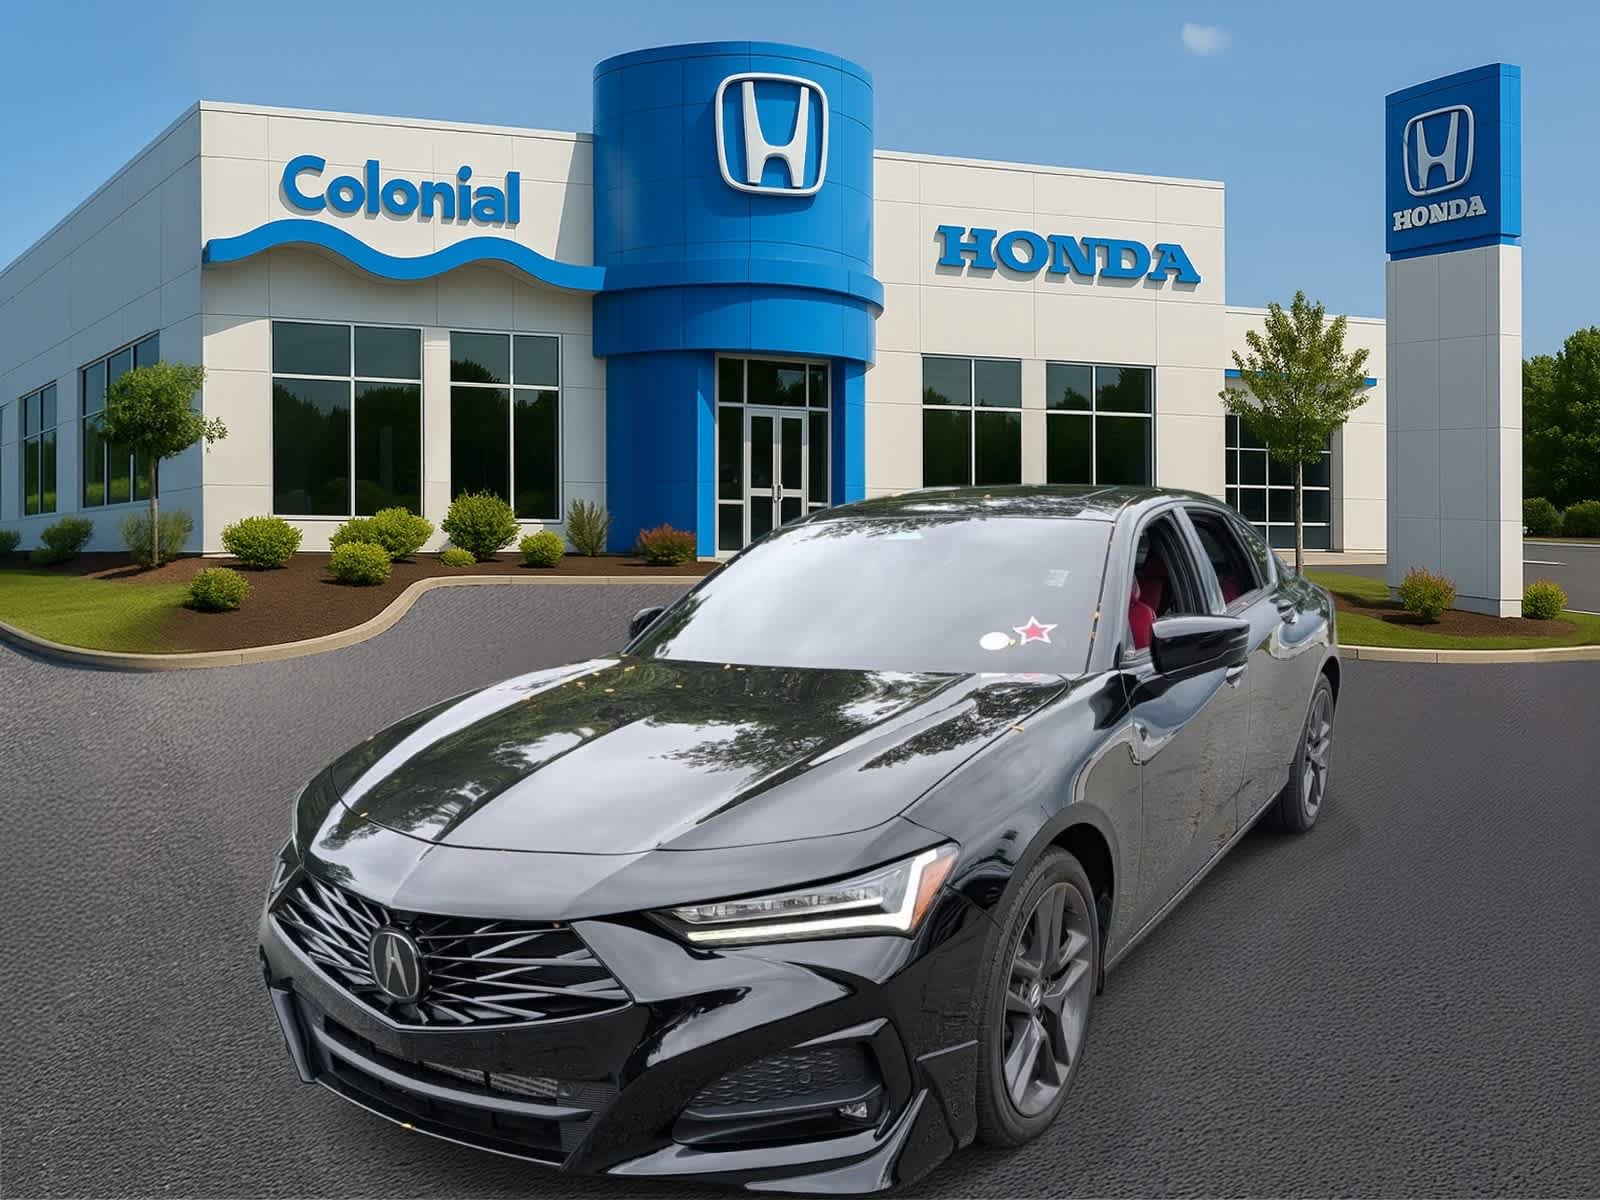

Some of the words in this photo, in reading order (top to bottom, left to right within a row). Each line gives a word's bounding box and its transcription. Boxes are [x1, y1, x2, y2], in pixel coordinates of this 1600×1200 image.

[284, 155, 520, 225] Colonial
[1393, 195, 1487, 231] HONDA
[937, 225, 1200, 284] HONDA
